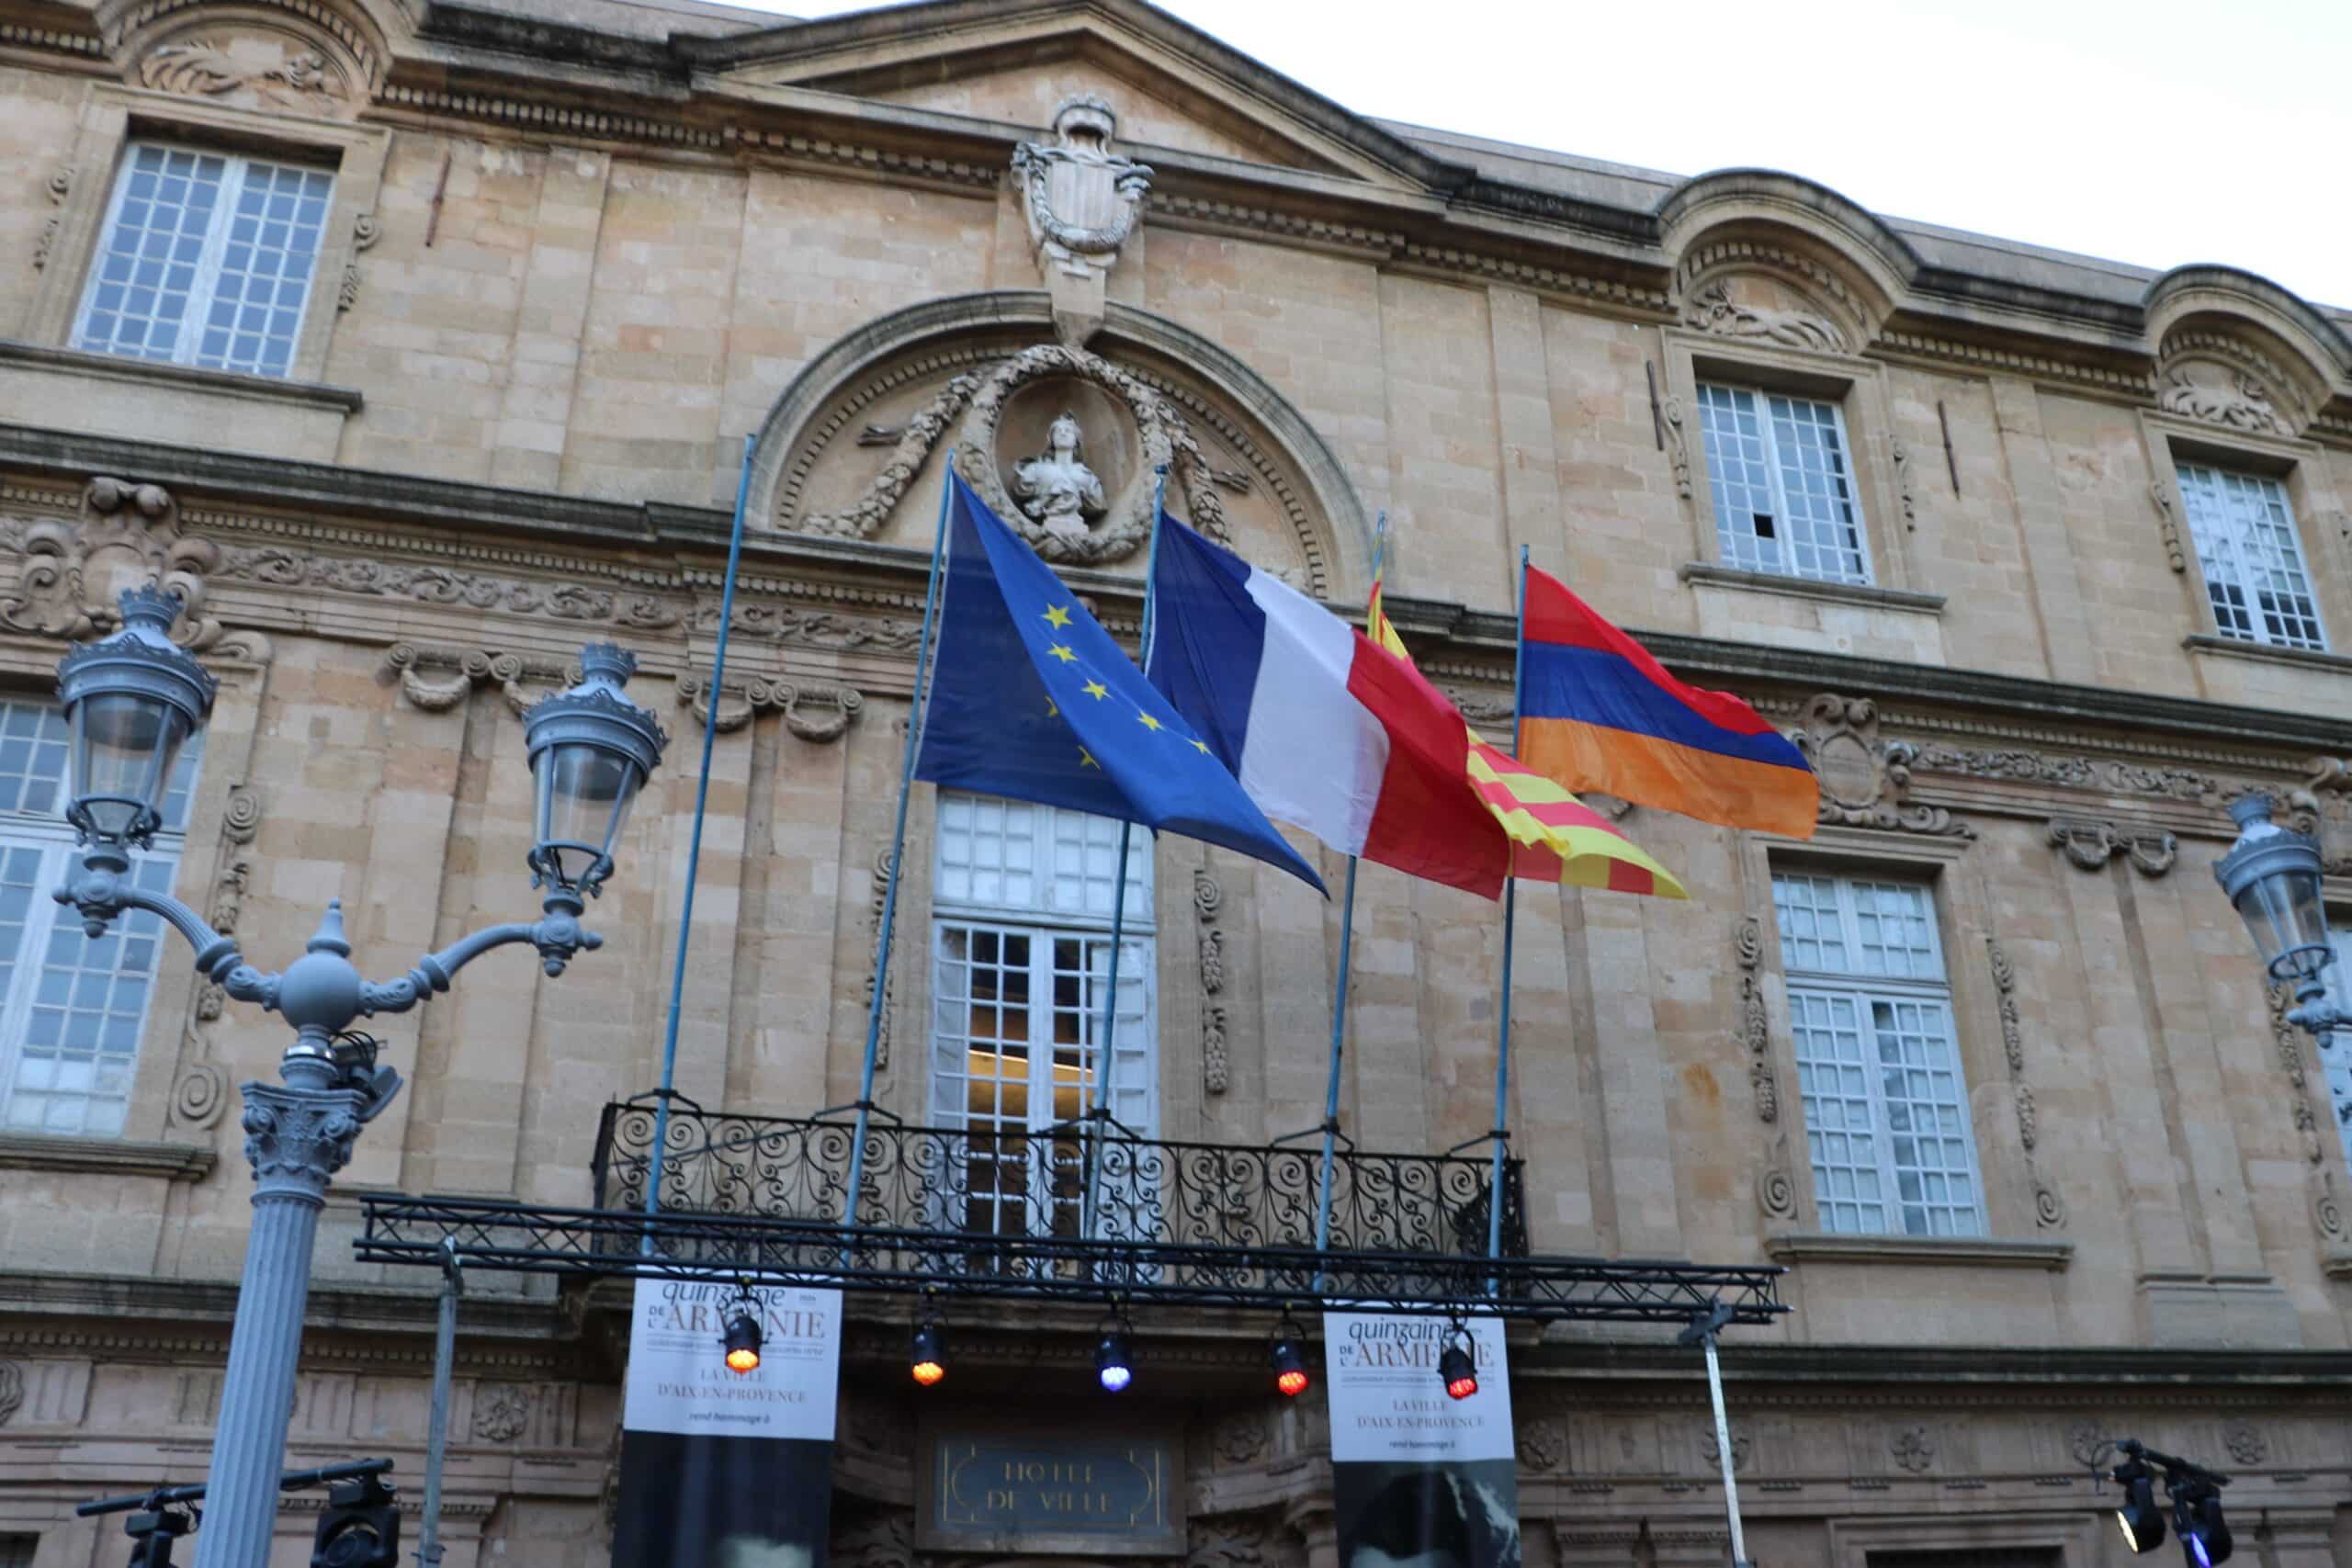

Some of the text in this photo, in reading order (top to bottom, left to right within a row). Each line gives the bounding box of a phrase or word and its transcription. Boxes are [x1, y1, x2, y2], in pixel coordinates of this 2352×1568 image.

[1349, 1316, 1453, 1347] quinzaine
[1340, 1344, 1353, 1355] DE
[1040, 1491, 1112, 1514] VILLE
